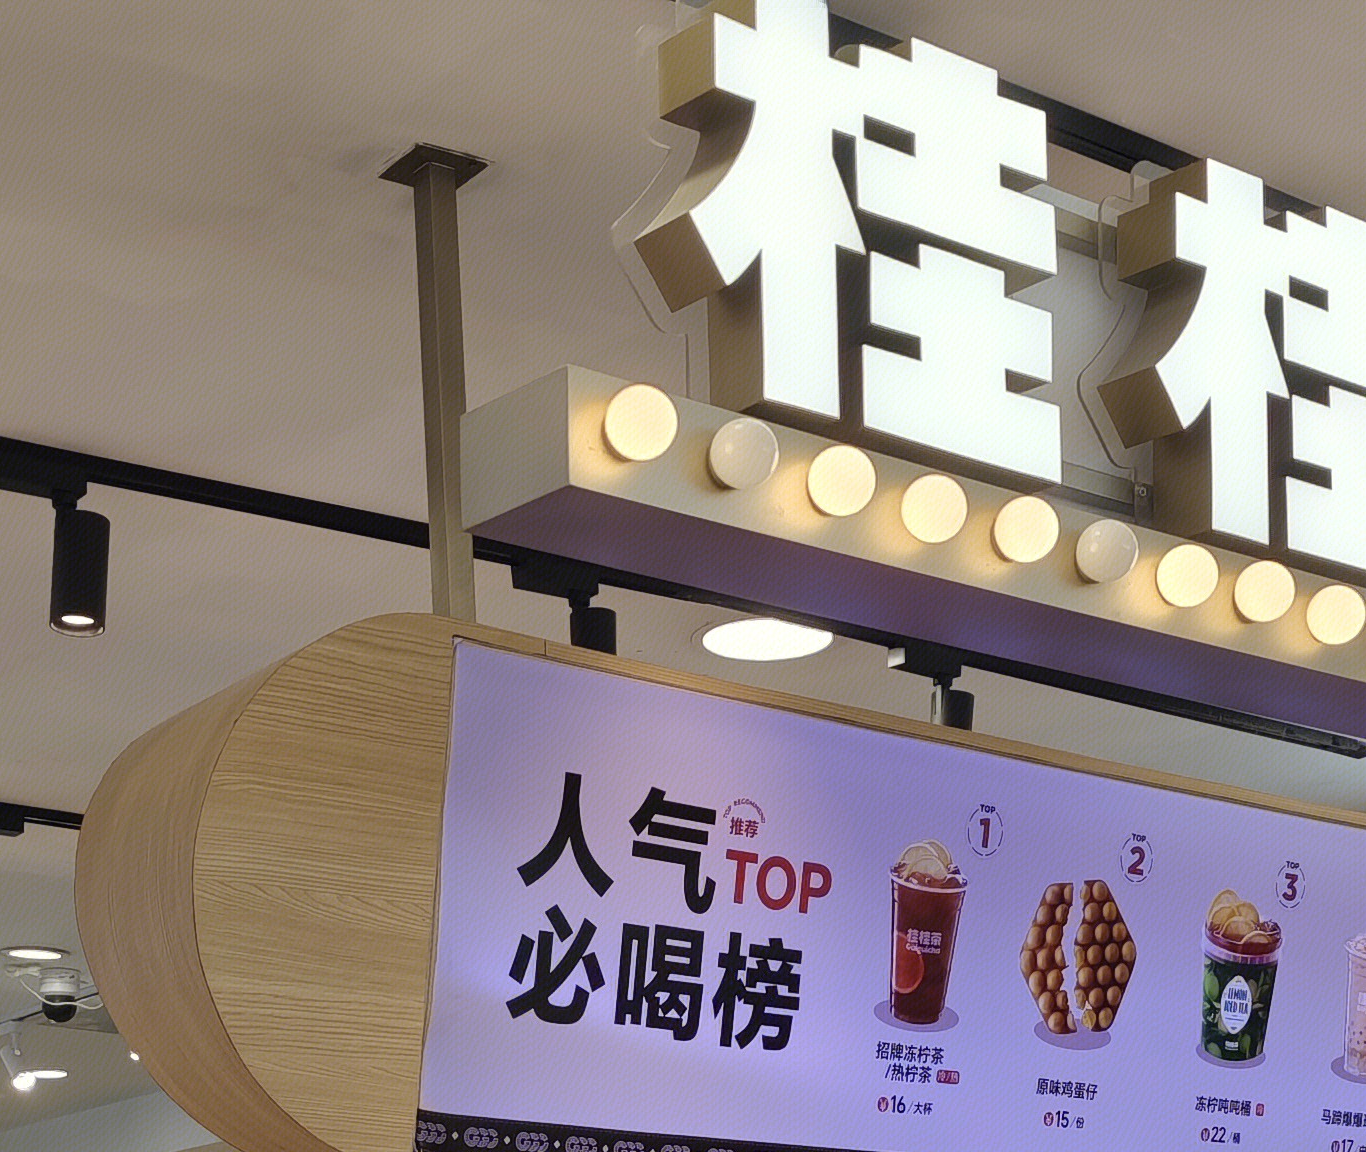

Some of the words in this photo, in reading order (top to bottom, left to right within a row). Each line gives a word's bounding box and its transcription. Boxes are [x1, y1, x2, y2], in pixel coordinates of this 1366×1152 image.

[729, 816, 760, 839] 推荐
[979, 818, 990, 848] 1
[516, 772, 717, 914] 人气
[1127, 846, 1145, 877] 2
[725, 848, 832, 914] TOP
[1282, 873, 1298, 901] 3
[505, 903, 804, 1051] 必喝榜
[875, 1041, 944, 1065] 招牌冻柠茶
[885, 1064, 932, 1084] /热柠茶
[1036, 1078, 1098, 1101] 原味鸡蛋仔
[1195, 1095, 1252, 1117] 冻柠吨吨桶
